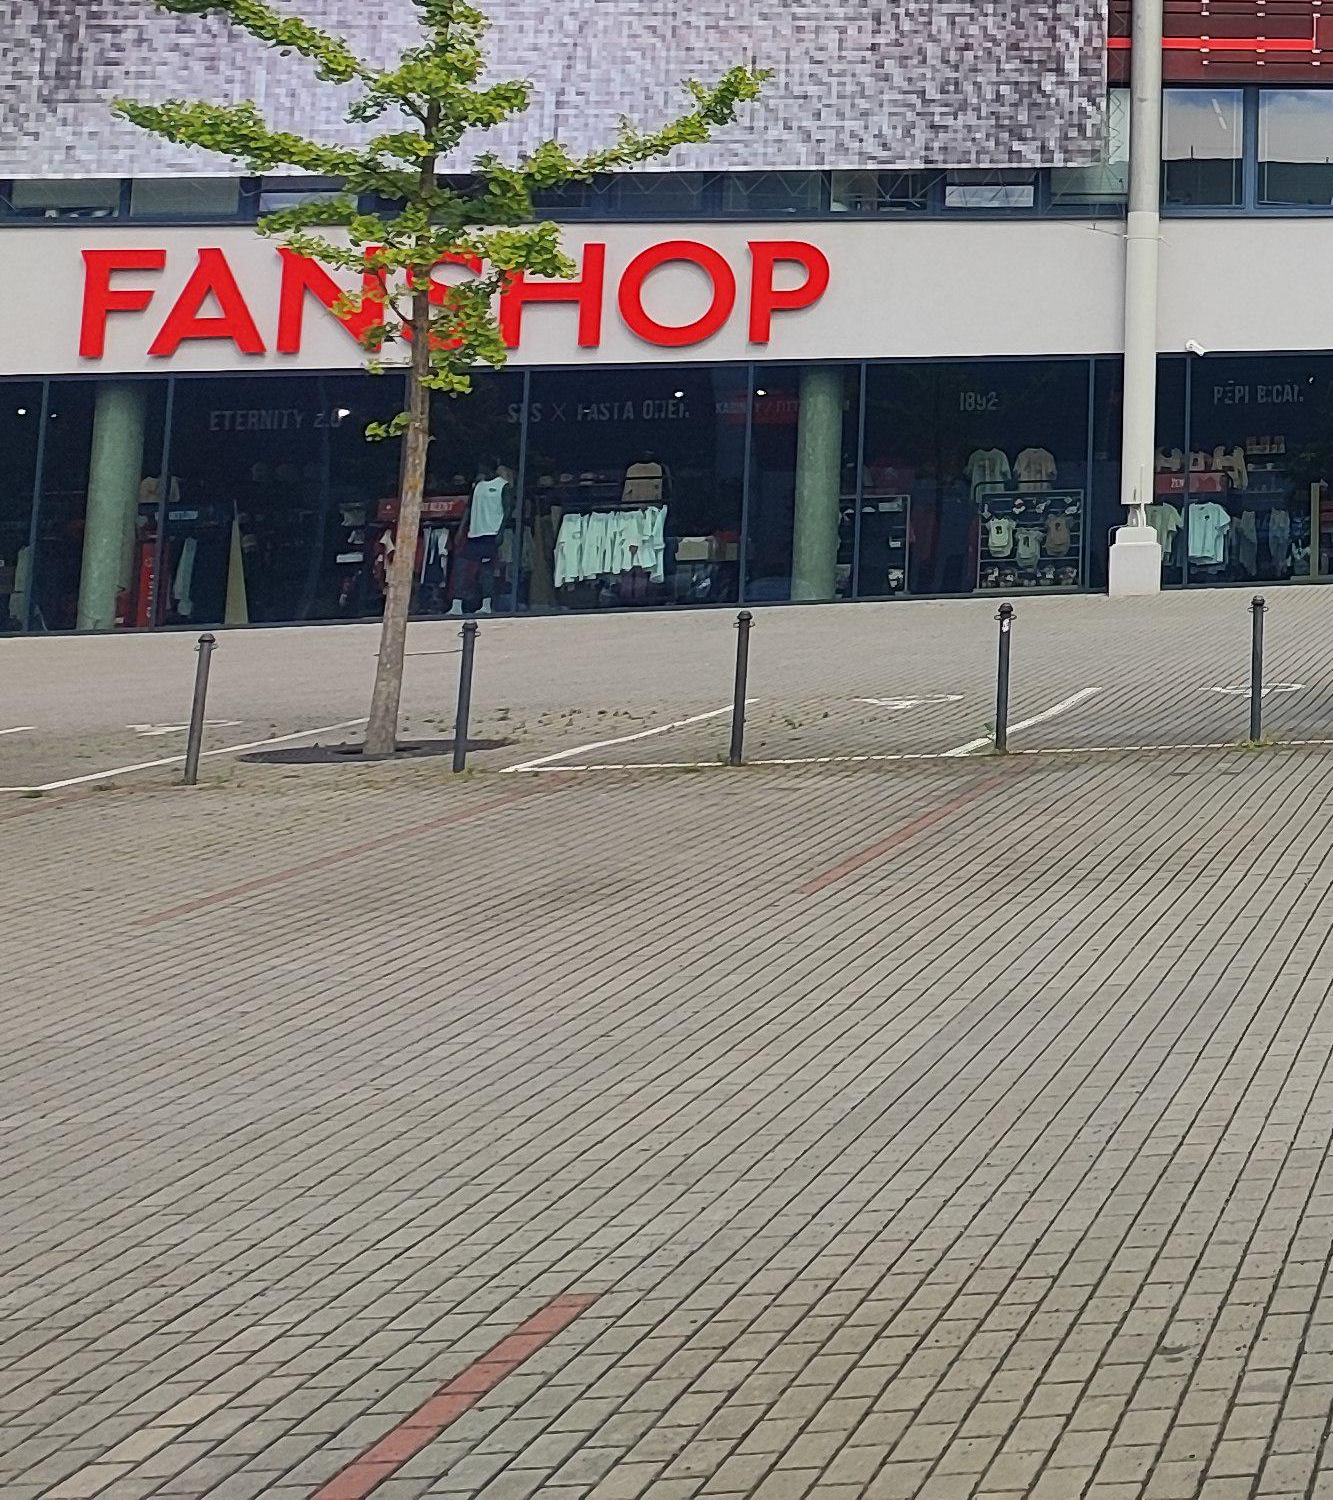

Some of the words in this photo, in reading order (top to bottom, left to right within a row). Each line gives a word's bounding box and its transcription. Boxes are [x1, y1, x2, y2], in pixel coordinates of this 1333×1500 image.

[959, 391, 999, 412] 1892
[209, 410, 303, 431] ETERNITY
[508, 403, 542, 424] SS
